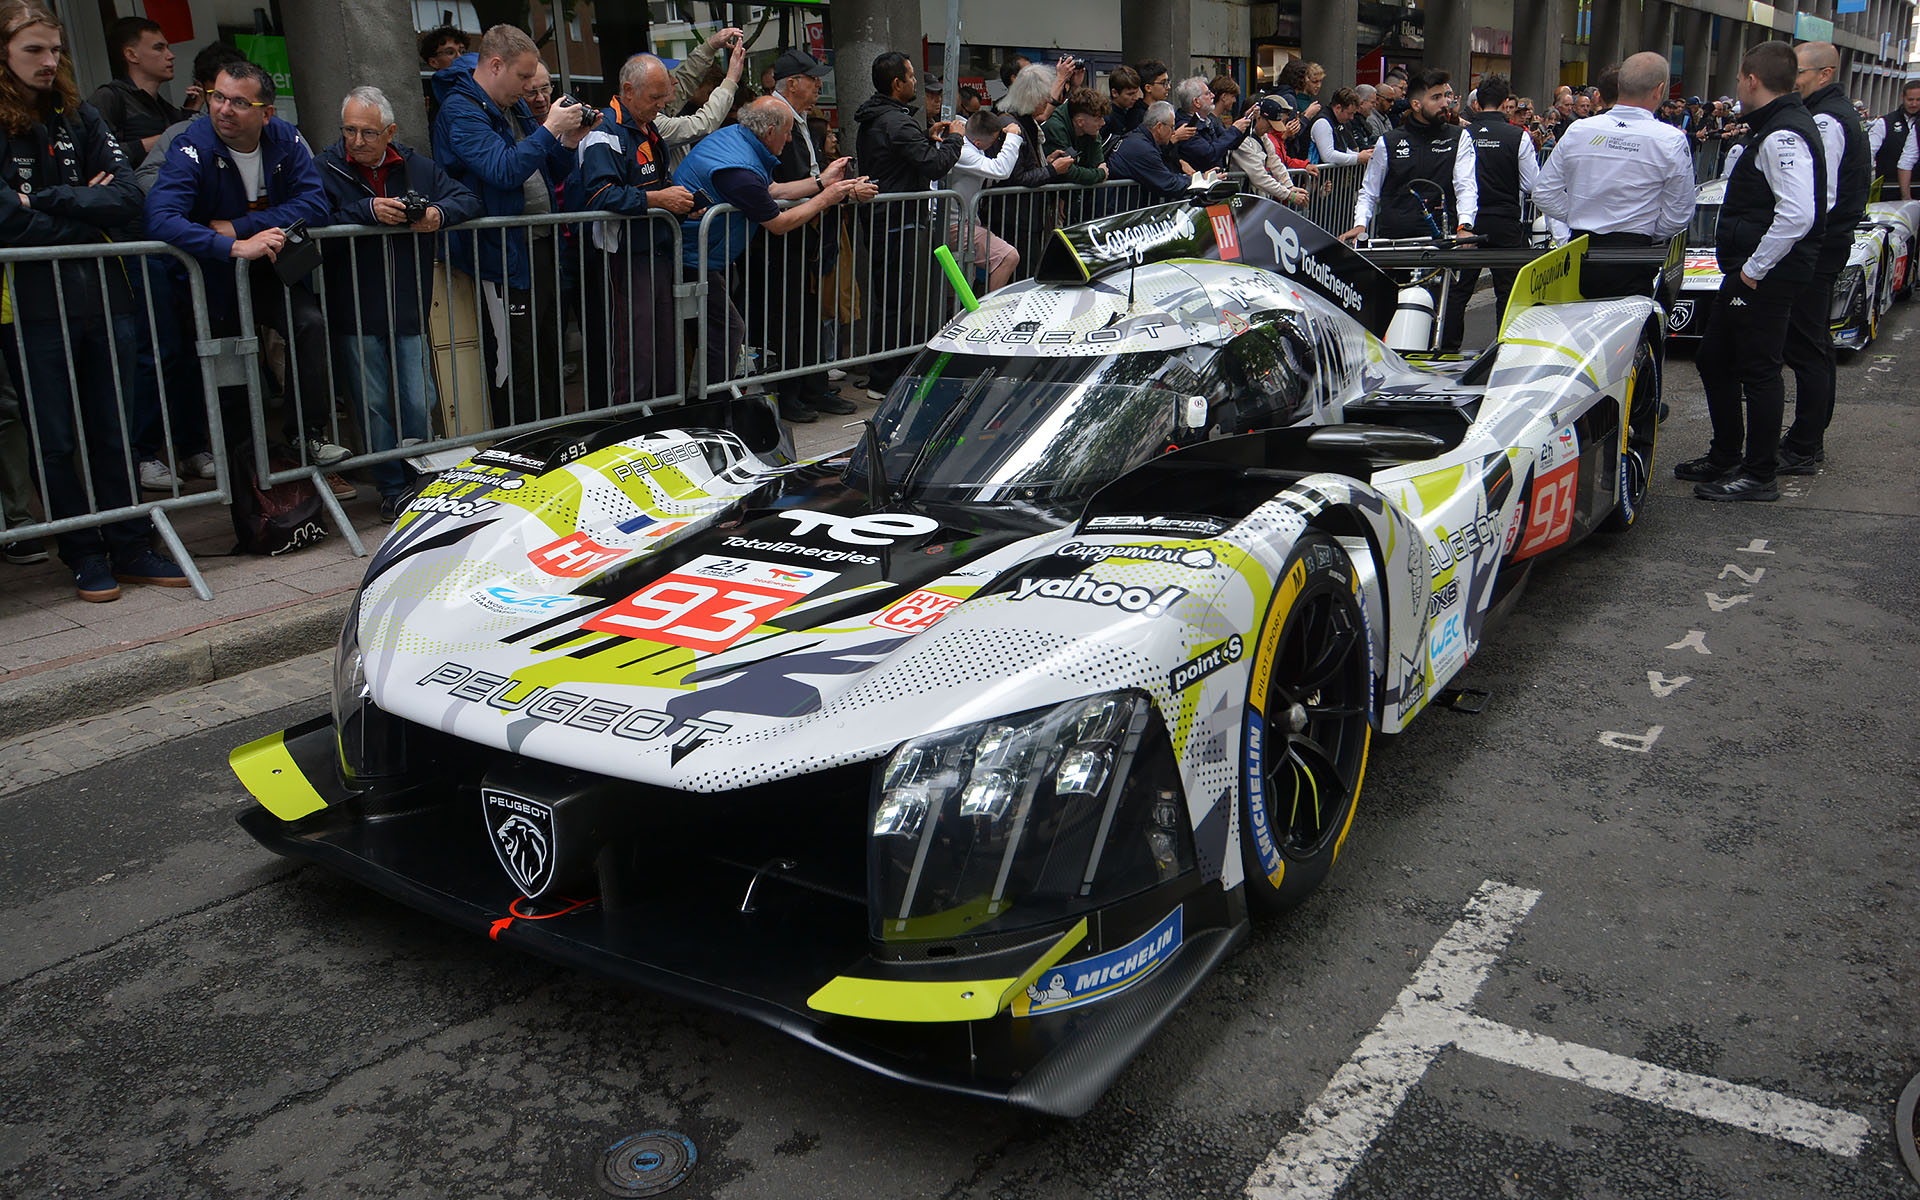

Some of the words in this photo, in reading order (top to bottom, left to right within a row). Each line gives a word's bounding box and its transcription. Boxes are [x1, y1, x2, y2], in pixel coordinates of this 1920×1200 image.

[1212, 215, 1234, 249] HY
[1300, 247, 1363, 312] TotalEnergies
[560, 441, 587, 463] #93
[613, 437, 709, 483] PEUGEOT
[1523, 471, 1576, 551] 93
[543, 540, 619, 571] HY
[720, 536, 881, 565] TotalEnergies
[1057, 542, 1183, 562] Capgemini
[600, 581, 784, 642] 93
[1010, 574, 1188, 616] yahoo!
[1258, 655, 1269, 699] PILOT
[1266, 611, 1282, 656] SPORT
[416, 661, 734, 749] PEUGEOT
[489, 796, 549, 820] PEUGEOT
[1250, 725, 1273, 857] MICHELIN
[1074, 925, 1174, 992] MICHELIN
